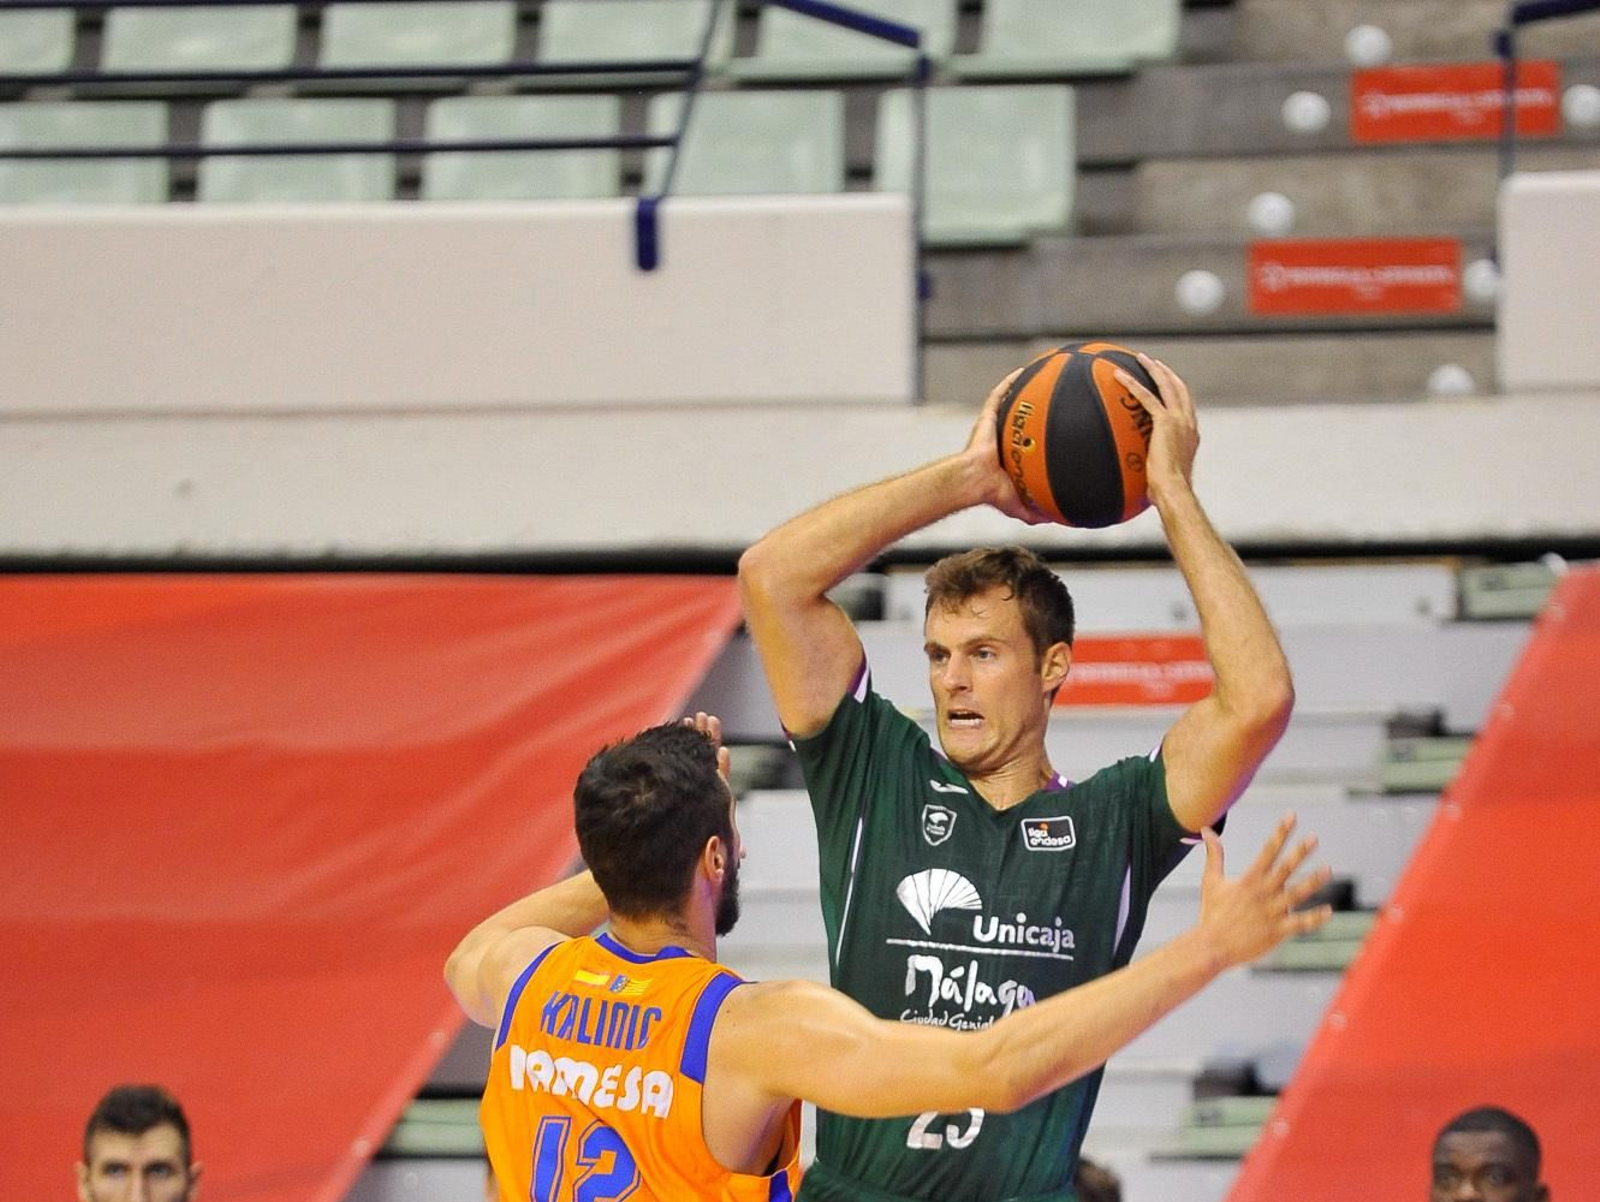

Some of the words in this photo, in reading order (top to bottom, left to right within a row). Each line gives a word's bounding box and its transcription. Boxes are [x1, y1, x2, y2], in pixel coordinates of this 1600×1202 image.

[973, 912, 1075, 953] Unicaja
[905, 954, 1037, 1016] Málaga
[900, 1008, 949, 1026] Ciudad
[950, 1012, 995, 1031] Genial
